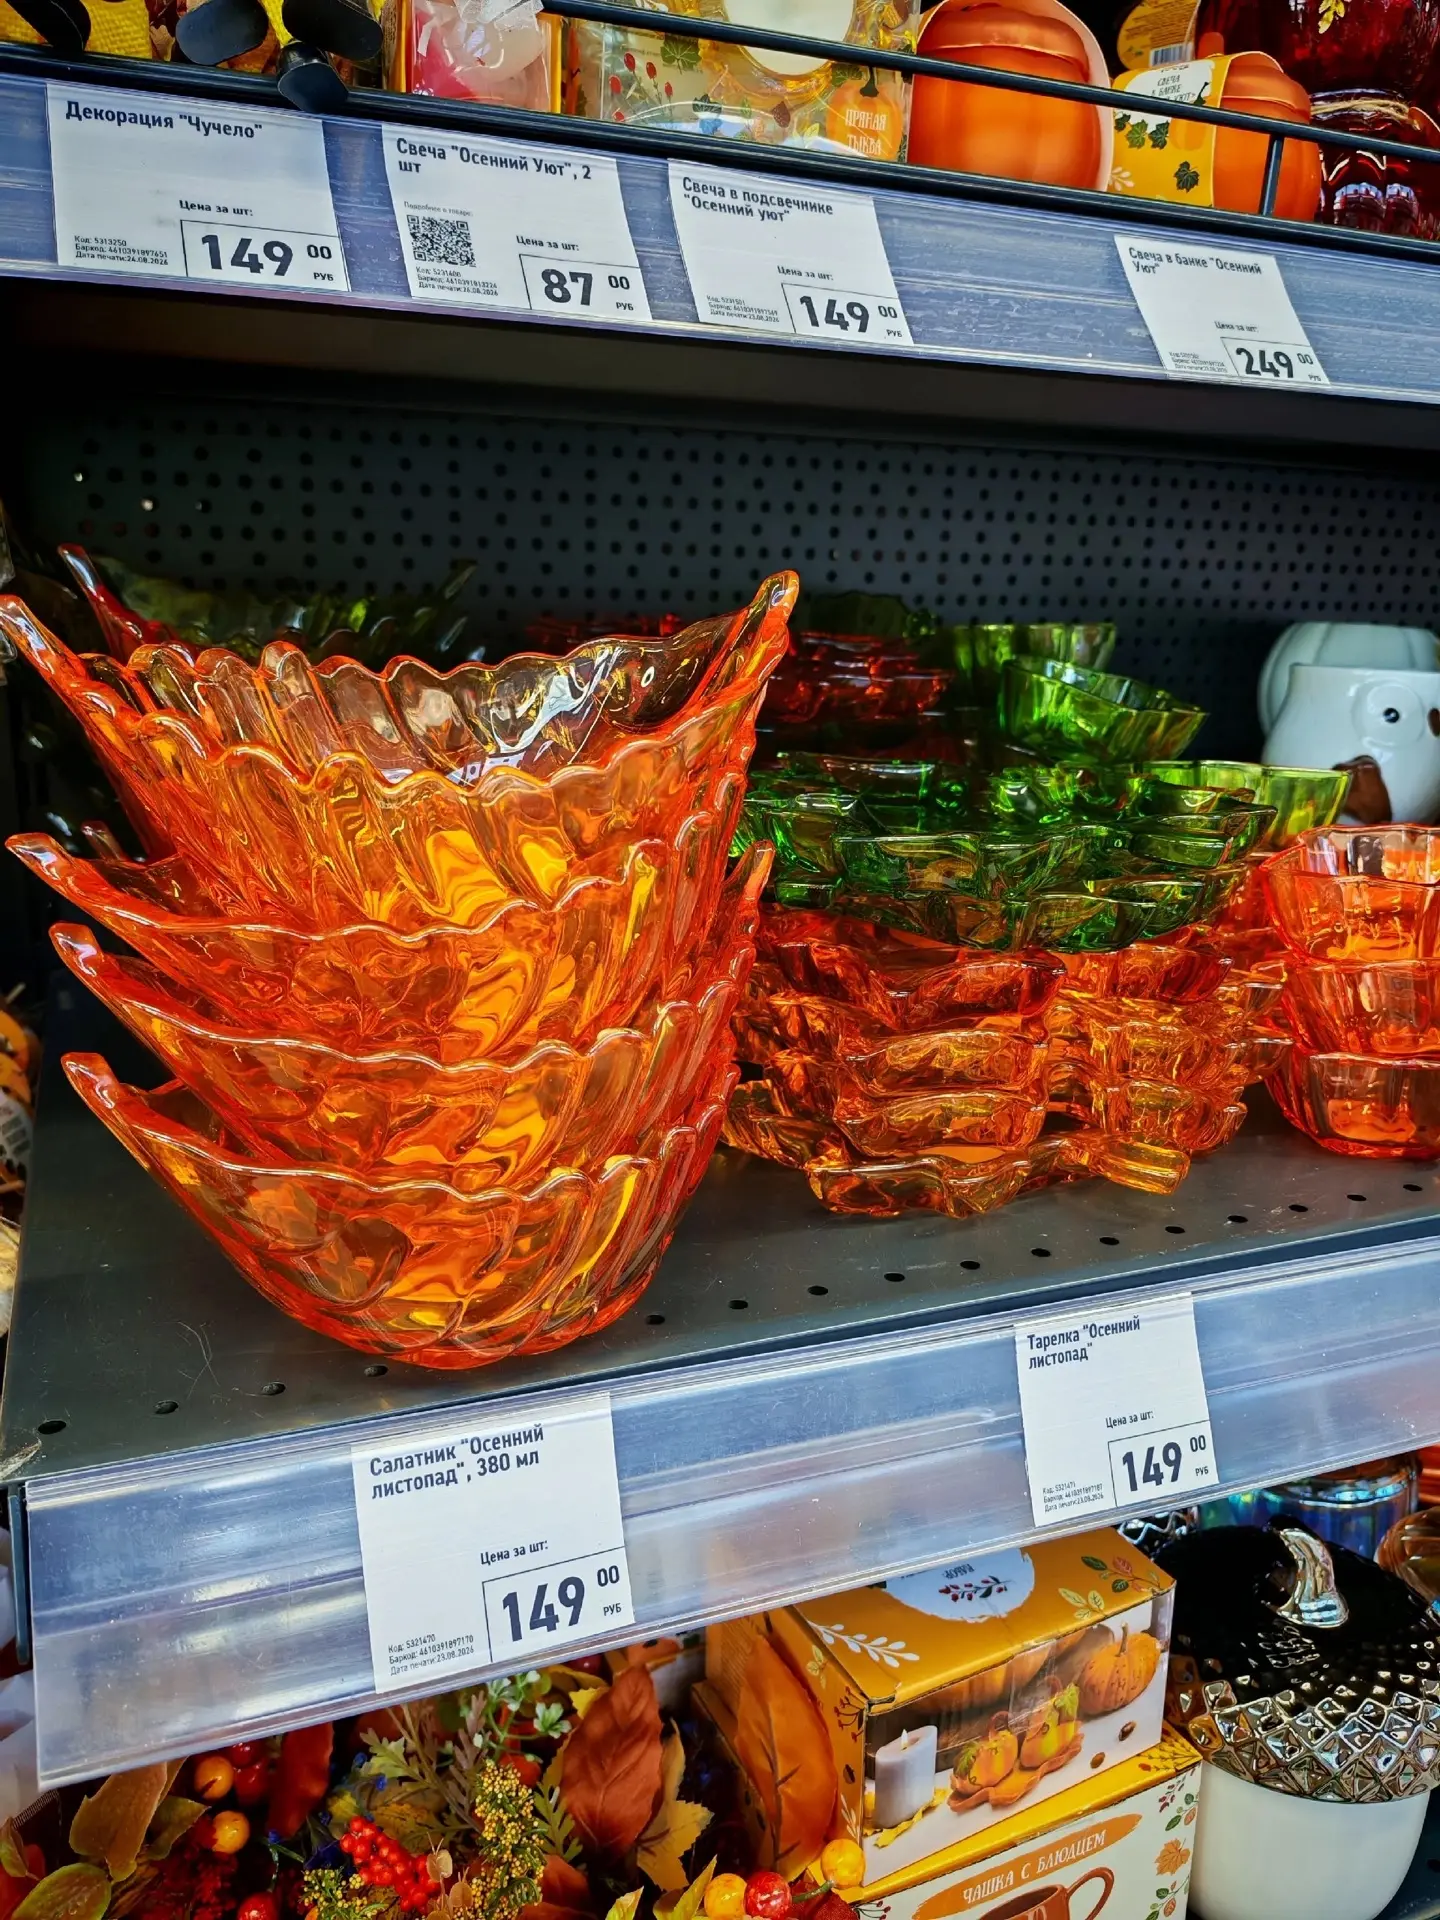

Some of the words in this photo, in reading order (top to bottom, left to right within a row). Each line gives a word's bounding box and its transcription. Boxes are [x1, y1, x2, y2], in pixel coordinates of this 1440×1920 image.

[66, 101, 174, 129] Декорация
[179, 114, 263, 139] "Чучело"
[845, 109, 887, 131] ПРЯНАЯ
[396, 138, 447, 160] Свеча
[451, 145, 528, 172] "Осенний
[582, 165, 592, 180] 2
[398, 161, 421, 174] шт
[683, 177, 726, 198] Свеча
[730, 188, 738, 199] в
[743, 192, 833, 215] подсвечнике
[179, 200, 212, 213] Цена
[216, 203, 229, 214] за
[232, 206, 253, 217] шт:
[684, 194, 754, 217] "Осенний
[760, 208, 790, 222] уют"
[74, 235, 92, 244] Код:
[75, 243, 106, 253] Баркод:
[516, 235, 544, 248] Цена
[548, 241, 559, 250] за
[561, 243, 579, 252] шт:
[76, 251, 95, 259] Дата
[201, 234, 294, 276] 149
[307, 244, 332, 260] 00
[1129, 246, 1163, 263] Свеча
[1165, 253, 1173, 264] в
[1175, 253, 1208, 268] банке
[1210, 256, 1262, 275] "Осенний
[777, 265, 803, 278] Цена
[805, 271, 815, 279] за
[817, 272, 834, 281] шт:
[1133, 260, 1160, 275] Уют"
[313, 271, 334, 282] РУБ
[608, 275, 630, 290] 00
[540, 268, 593, 306] 87
[616, 301, 634, 311] РУБ
[800, 295, 869, 333] 149
[878, 305, 898, 319] 00
[886, 329, 902, 338] РУБ
[1214, 321, 1235, 331] Цена
[1236, 348, 1294, 379] 249
[1297, 353, 1314, 365] 00
[1309, 374, 1322, 382] РУБ
[1027, 1328, 1080, 1352] Тарелка
[1083, 1315, 1141, 1339] "Осенний
[1029, 1342, 1093, 1369] листопад"
[1106, 1415, 1127, 1428] Цена
[1129, 1414, 1139, 1423] за
[1140, 1410, 1155, 1422] шт:
[369, 1445, 457, 1477] Салатник
[460, 1423, 544, 1455] "Осенний
[1189, 1435, 1207, 1453] 00
[372, 1462, 472, 1499] листопад",
[476, 1455, 511, 1477] 380
[516, 1450, 540, 1469] мл
[1122, 1441, 1182, 1492] 149
[1195, 1466, 1209, 1477] РУБ
[480, 1549, 510, 1566] Цена
[513, 1546, 526, 1558] за
[529, 1540, 549, 1554] шт:
[597, 1565, 620, 1587] 00
[502, 1576, 585, 1642] 149
[603, 1602, 622, 1617] РУБ
[388, 1643, 404, 1653] Код:
[389, 1651, 418, 1664] Баркод:
[390, 1665, 408, 1676] Дата
[963, 1870, 1014, 1904] ЧАШКА
[1021, 1862, 1031, 1880] С
[1036, 1829, 1107, 1874] БЛЮДЦЕМ
